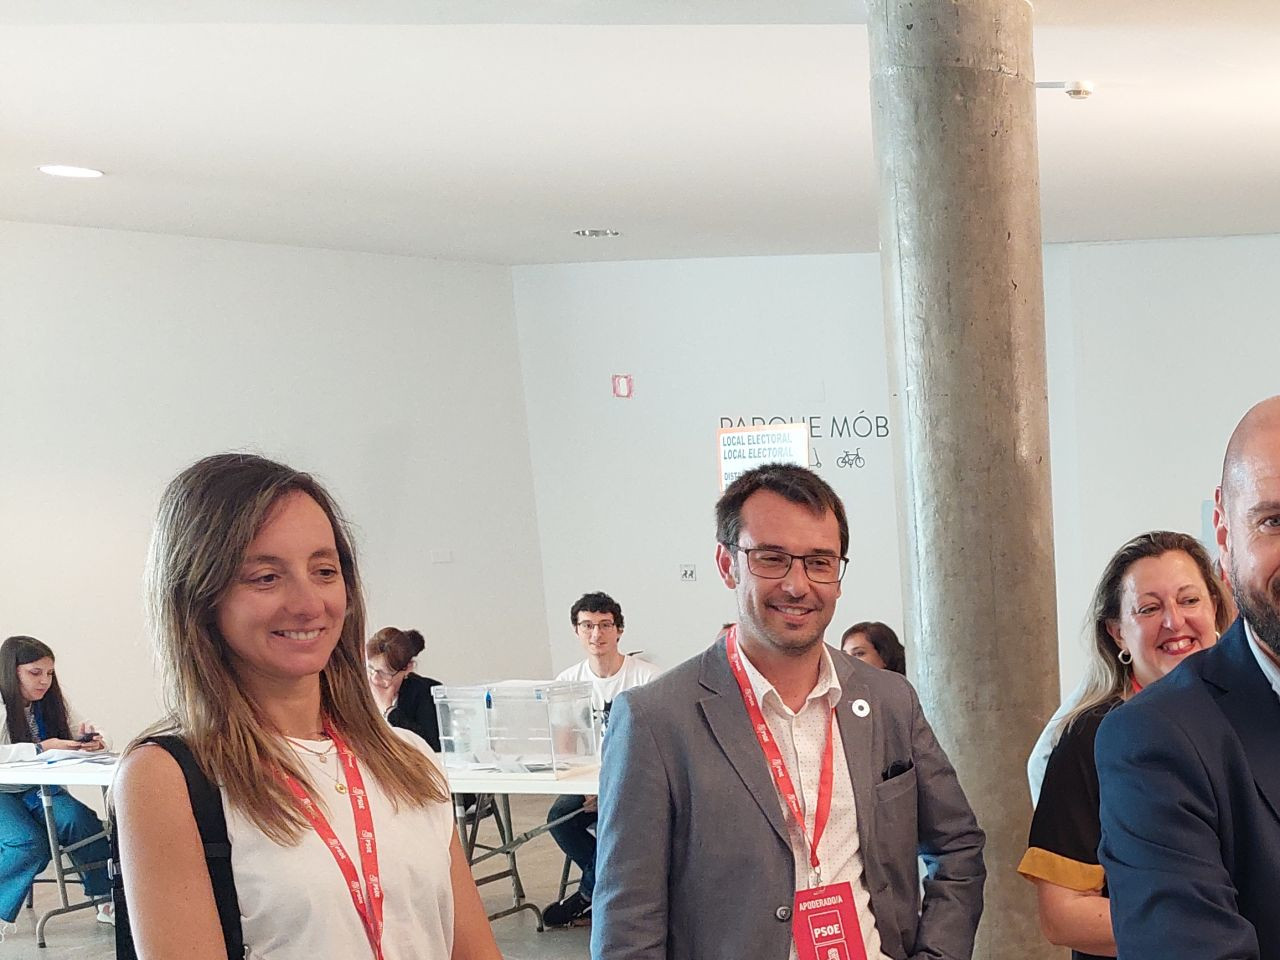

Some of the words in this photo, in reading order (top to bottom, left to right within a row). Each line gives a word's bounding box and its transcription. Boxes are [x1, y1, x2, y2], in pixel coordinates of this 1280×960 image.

[830, 410, 890, 438] MÓB
[722, 434, 746, 447] LOCAL
[747, 432, 792, 446] ELECTORAL
[723, 448, 746, 460] LOCAL
[748, 447, 794, 459] ELECTORAL
[799, 895, 843, 912] APODERADO/A
[814, 924, 841, 938] PSOE
